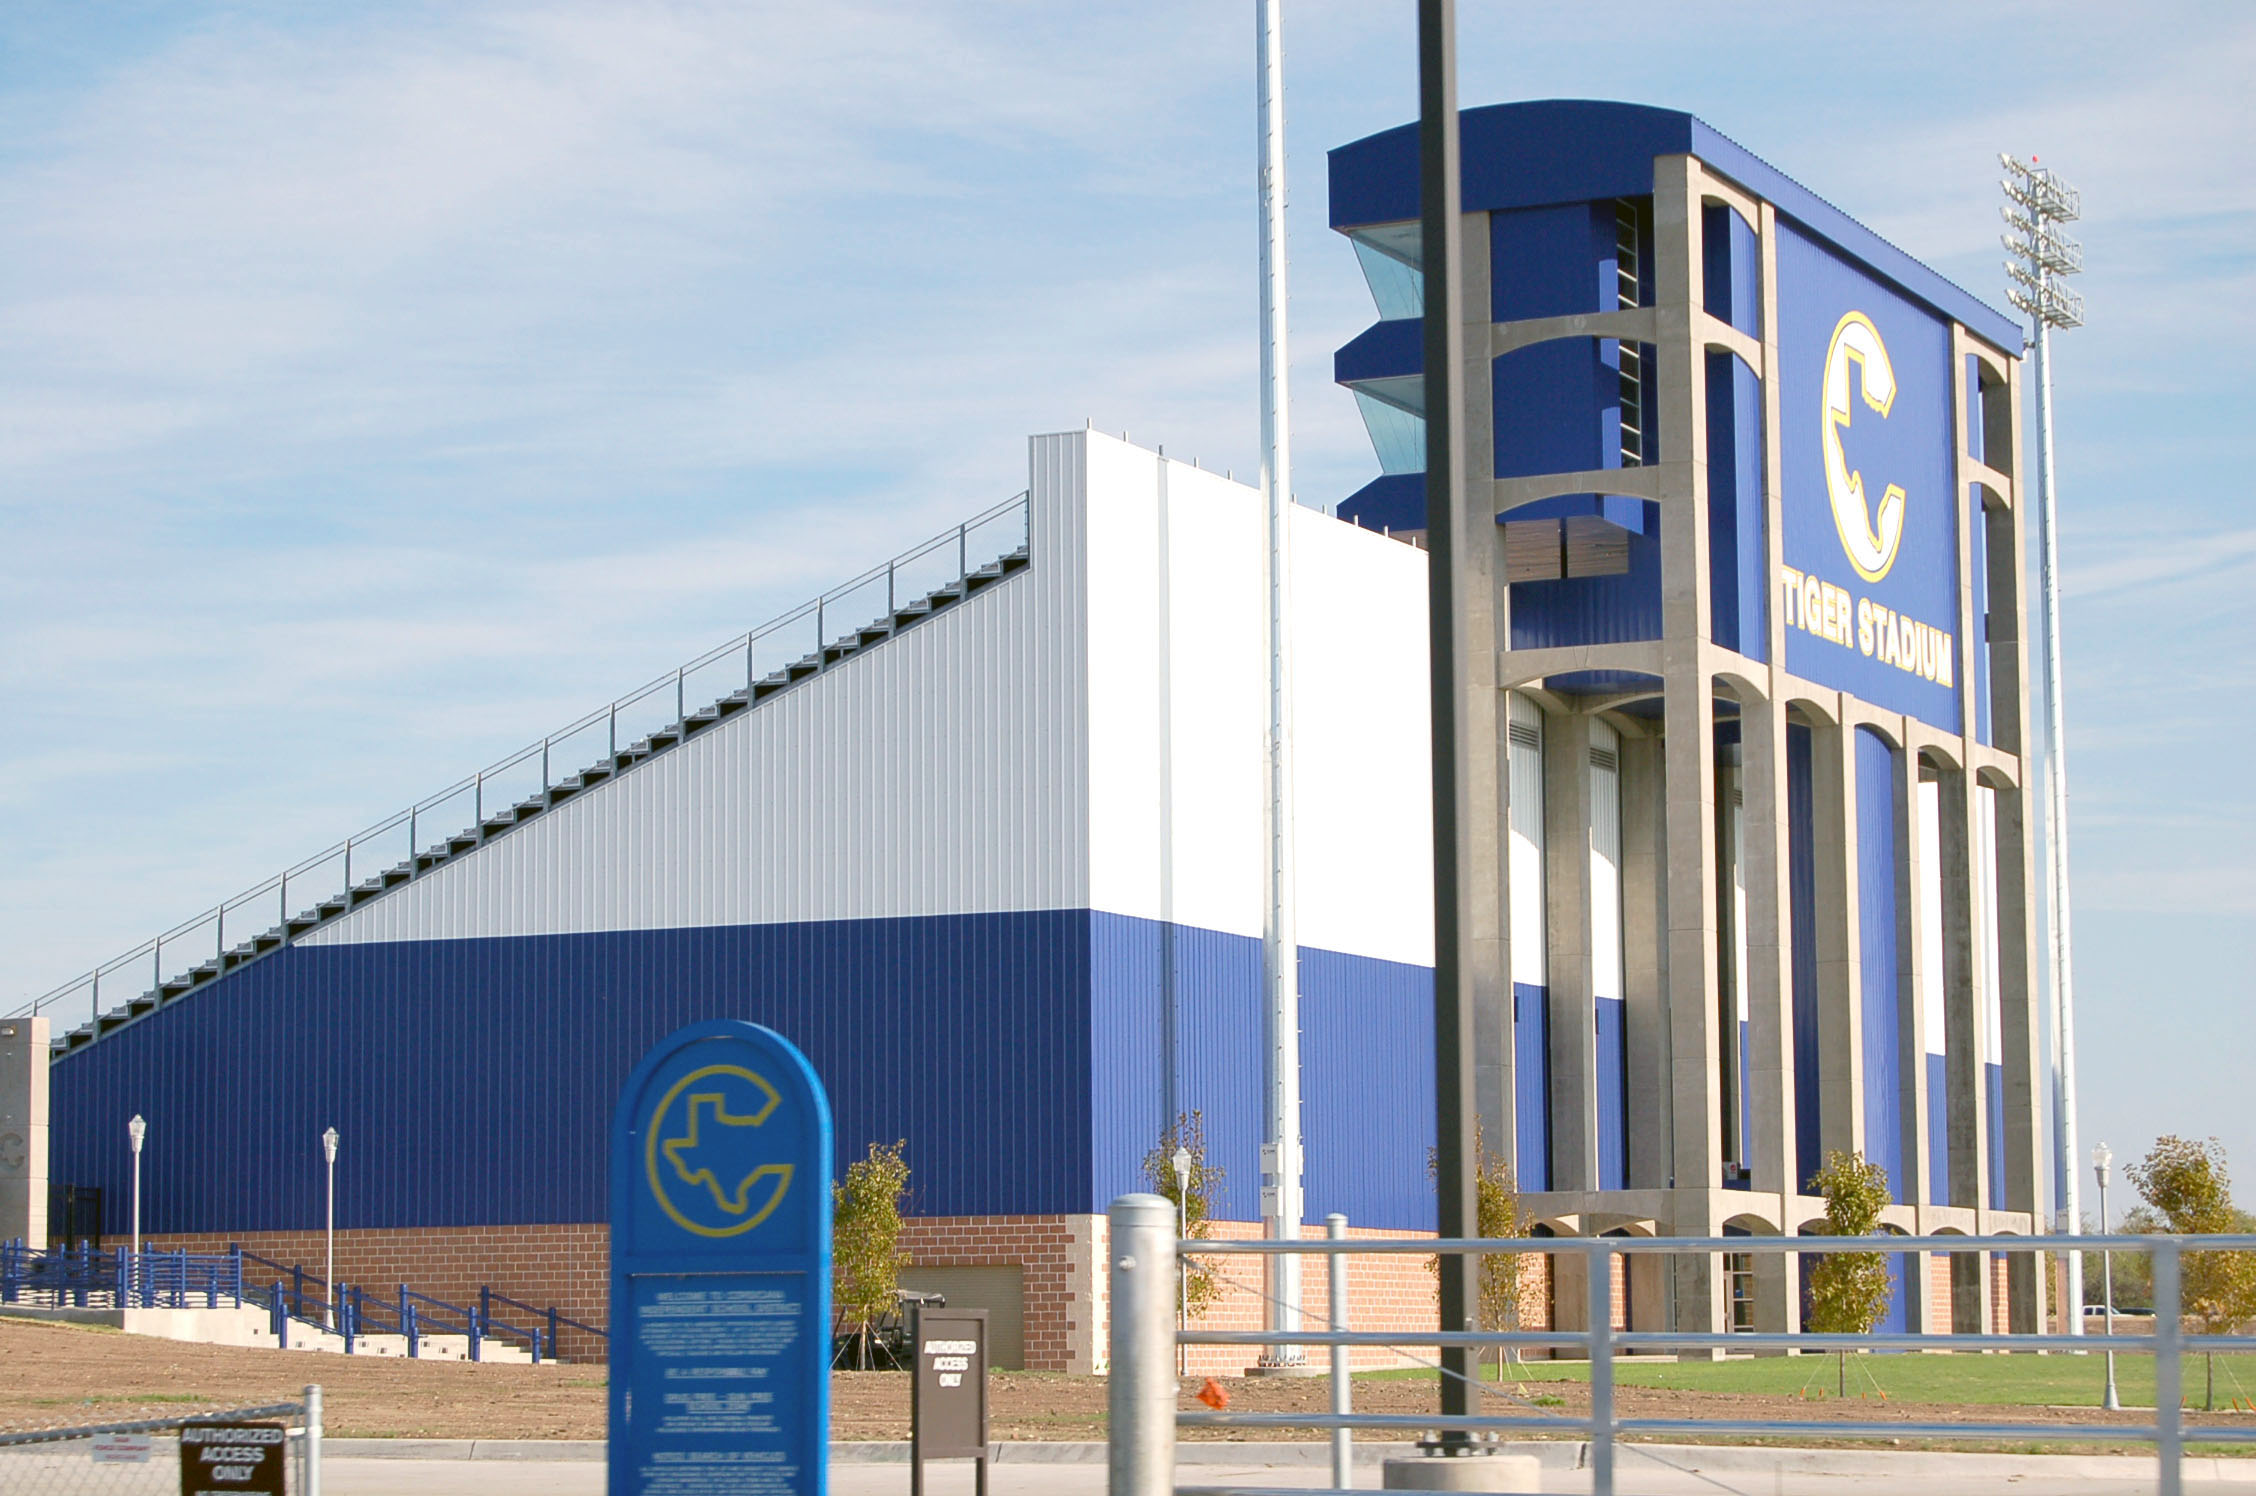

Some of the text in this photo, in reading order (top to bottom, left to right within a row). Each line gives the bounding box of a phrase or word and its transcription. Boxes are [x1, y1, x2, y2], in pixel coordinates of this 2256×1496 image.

[1781, 565, 1954, 688] TIGER STADIUM
[182, 1428, 284, 1443] AUTHORIZED
[200, 1446, 265, 1462] ACCESS
[212, 1465, 255, 1480] ONLY
